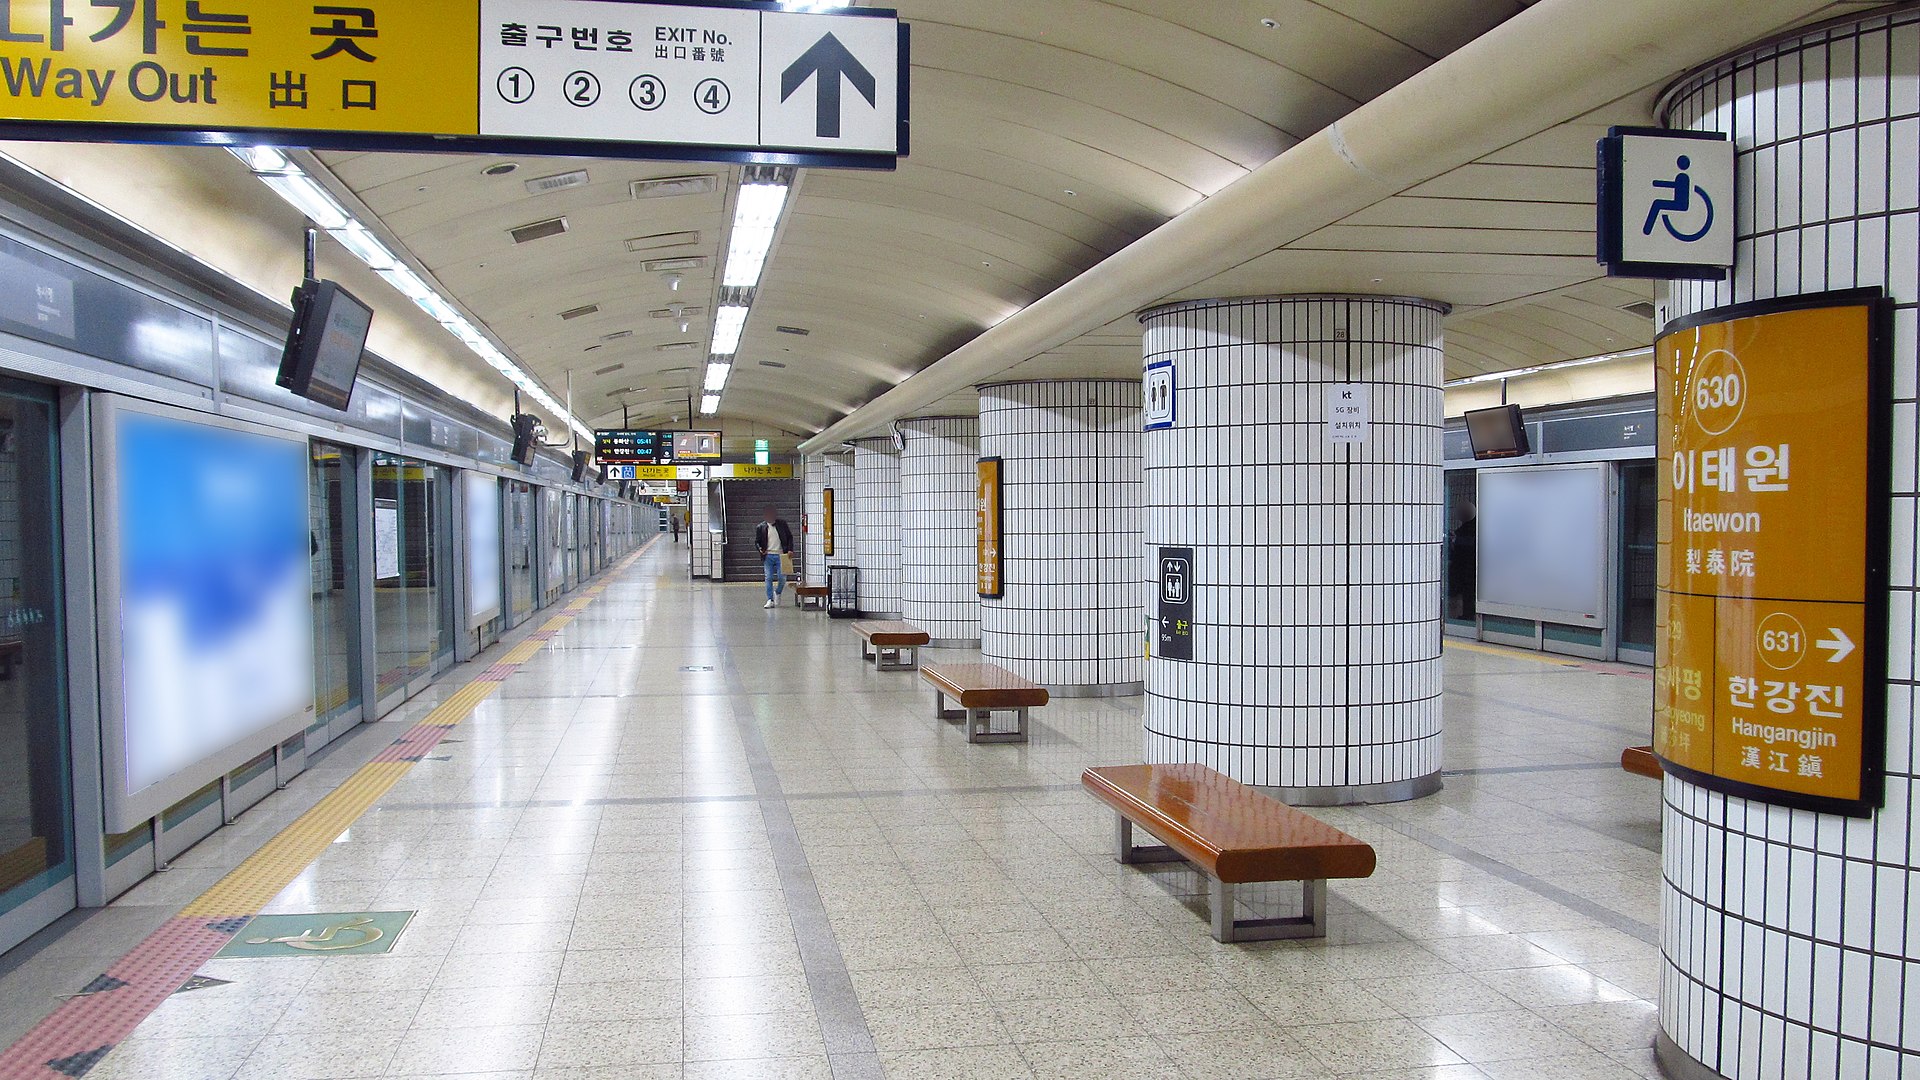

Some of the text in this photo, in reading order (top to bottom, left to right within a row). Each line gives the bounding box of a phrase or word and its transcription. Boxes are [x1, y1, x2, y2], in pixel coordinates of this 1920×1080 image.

[309, 5, 379, 63] 곳
[500, 22, 633, 52] 출구번호
[655, 26, 732, 46] EXIT No.
[654, 45, 725, 63] 出口番號
[0, 56, 217, 106] Way Out
[1342, 391, 1352, 399] kt
[1697, 374, 1740, 410] 630
[1672, 443, 1790, 494] 이태원
[1683, 508, 1760, 533] Itaewon
[1686, 548, 1756, 577] 梨泰院
[1762, 630, 1801, 653] 631
[1728, 676, 1844, 719] 한강진
[1732, 717, 1837, 749] Hangangjin
